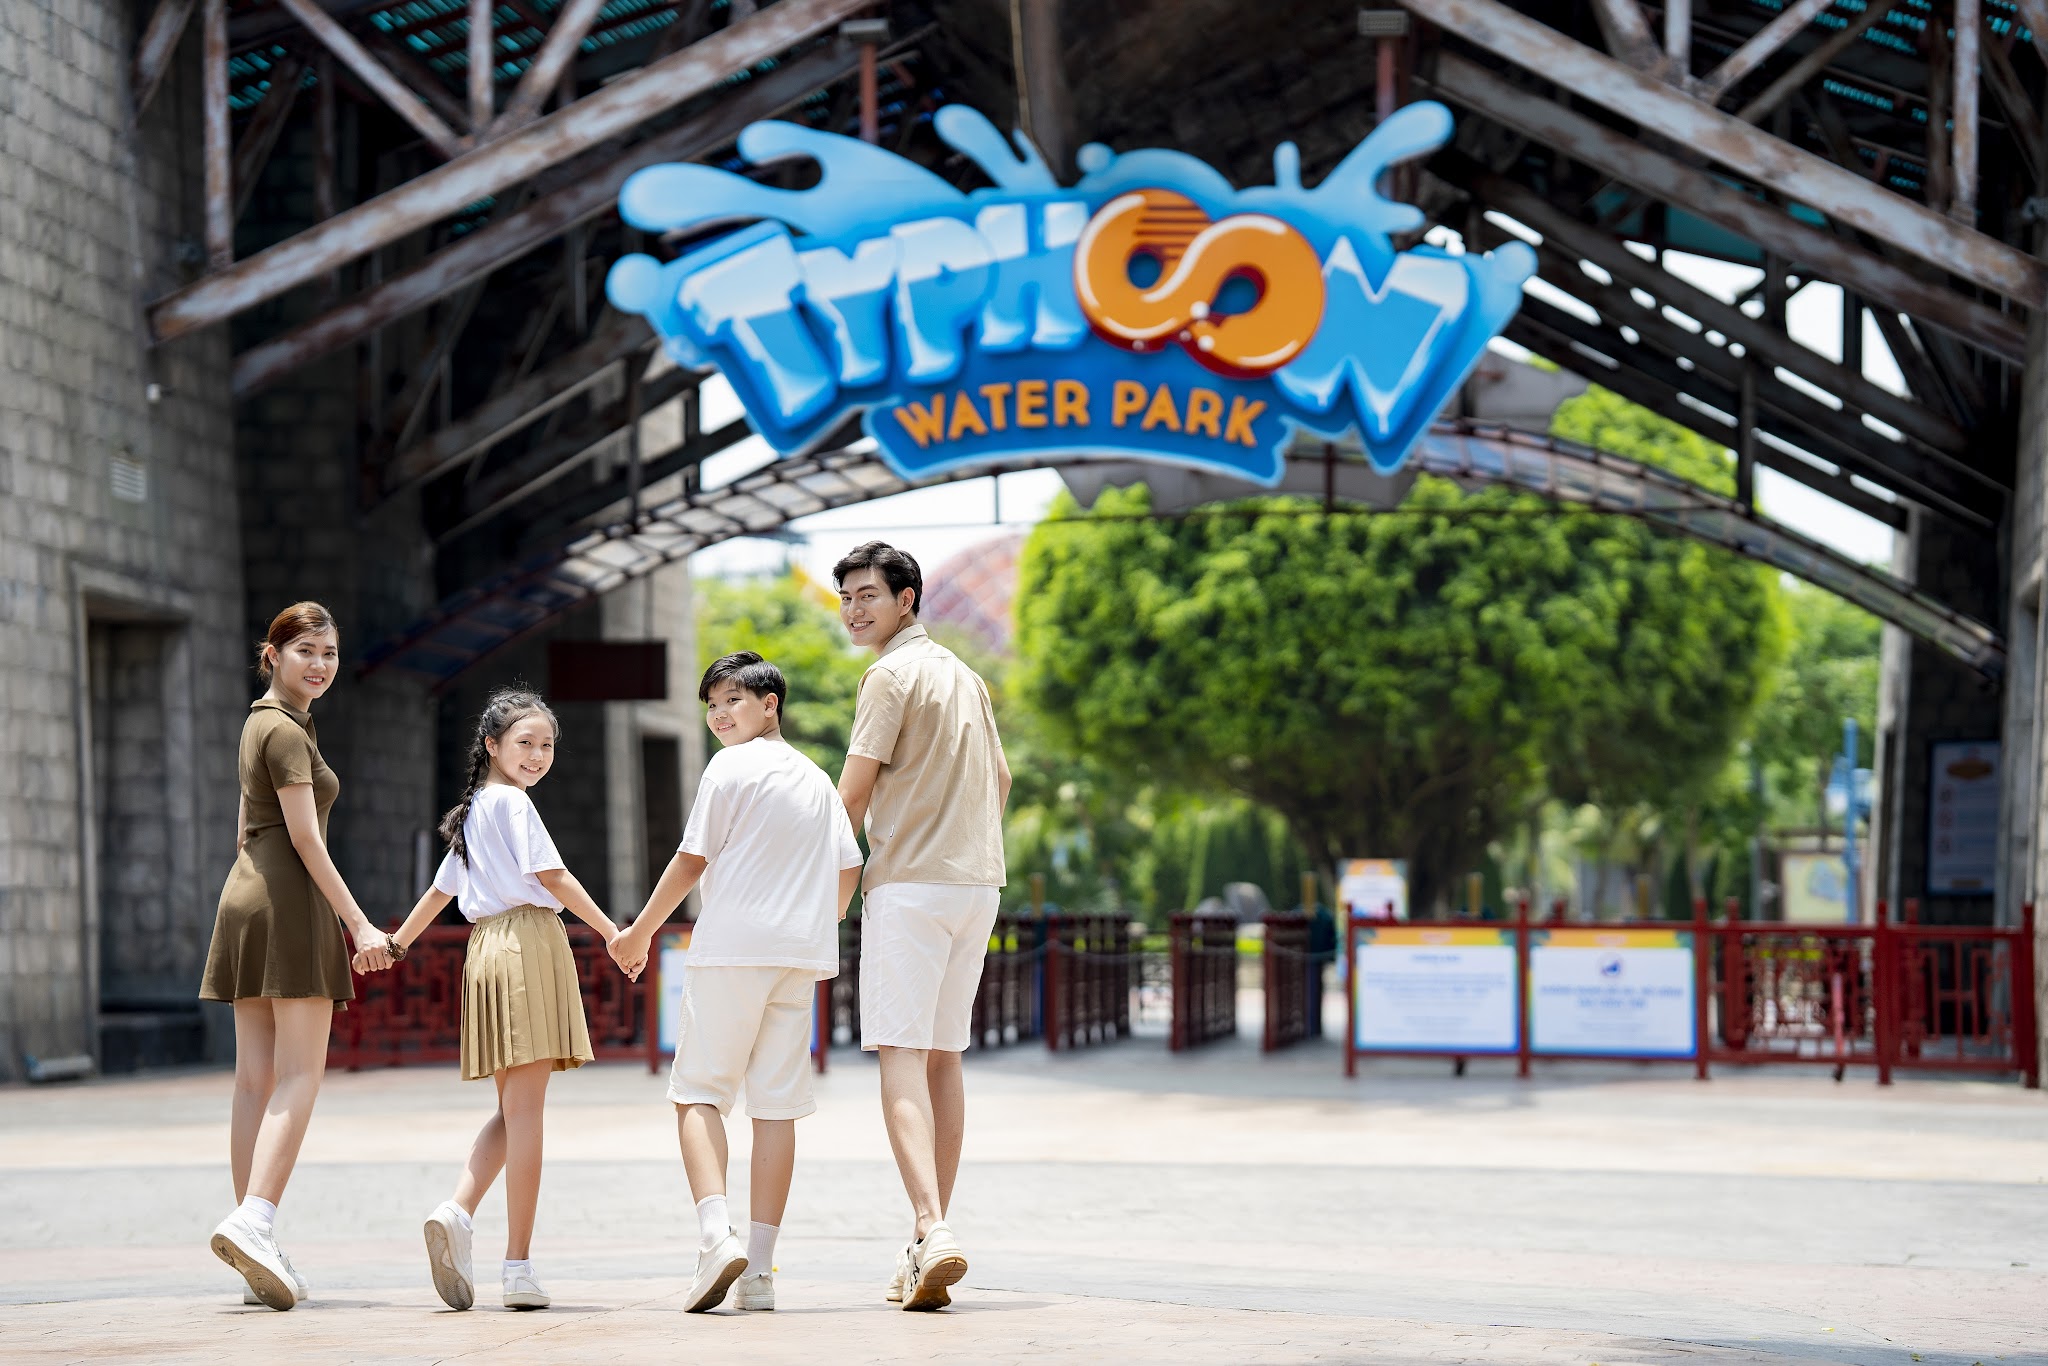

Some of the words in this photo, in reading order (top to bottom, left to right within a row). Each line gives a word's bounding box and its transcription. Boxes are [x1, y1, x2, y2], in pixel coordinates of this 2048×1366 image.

[677, 188, 1470, 443] TYPHOON
[893, 379, 1090, 448] WATER
[1111, 379, 1267, 448] PARK
